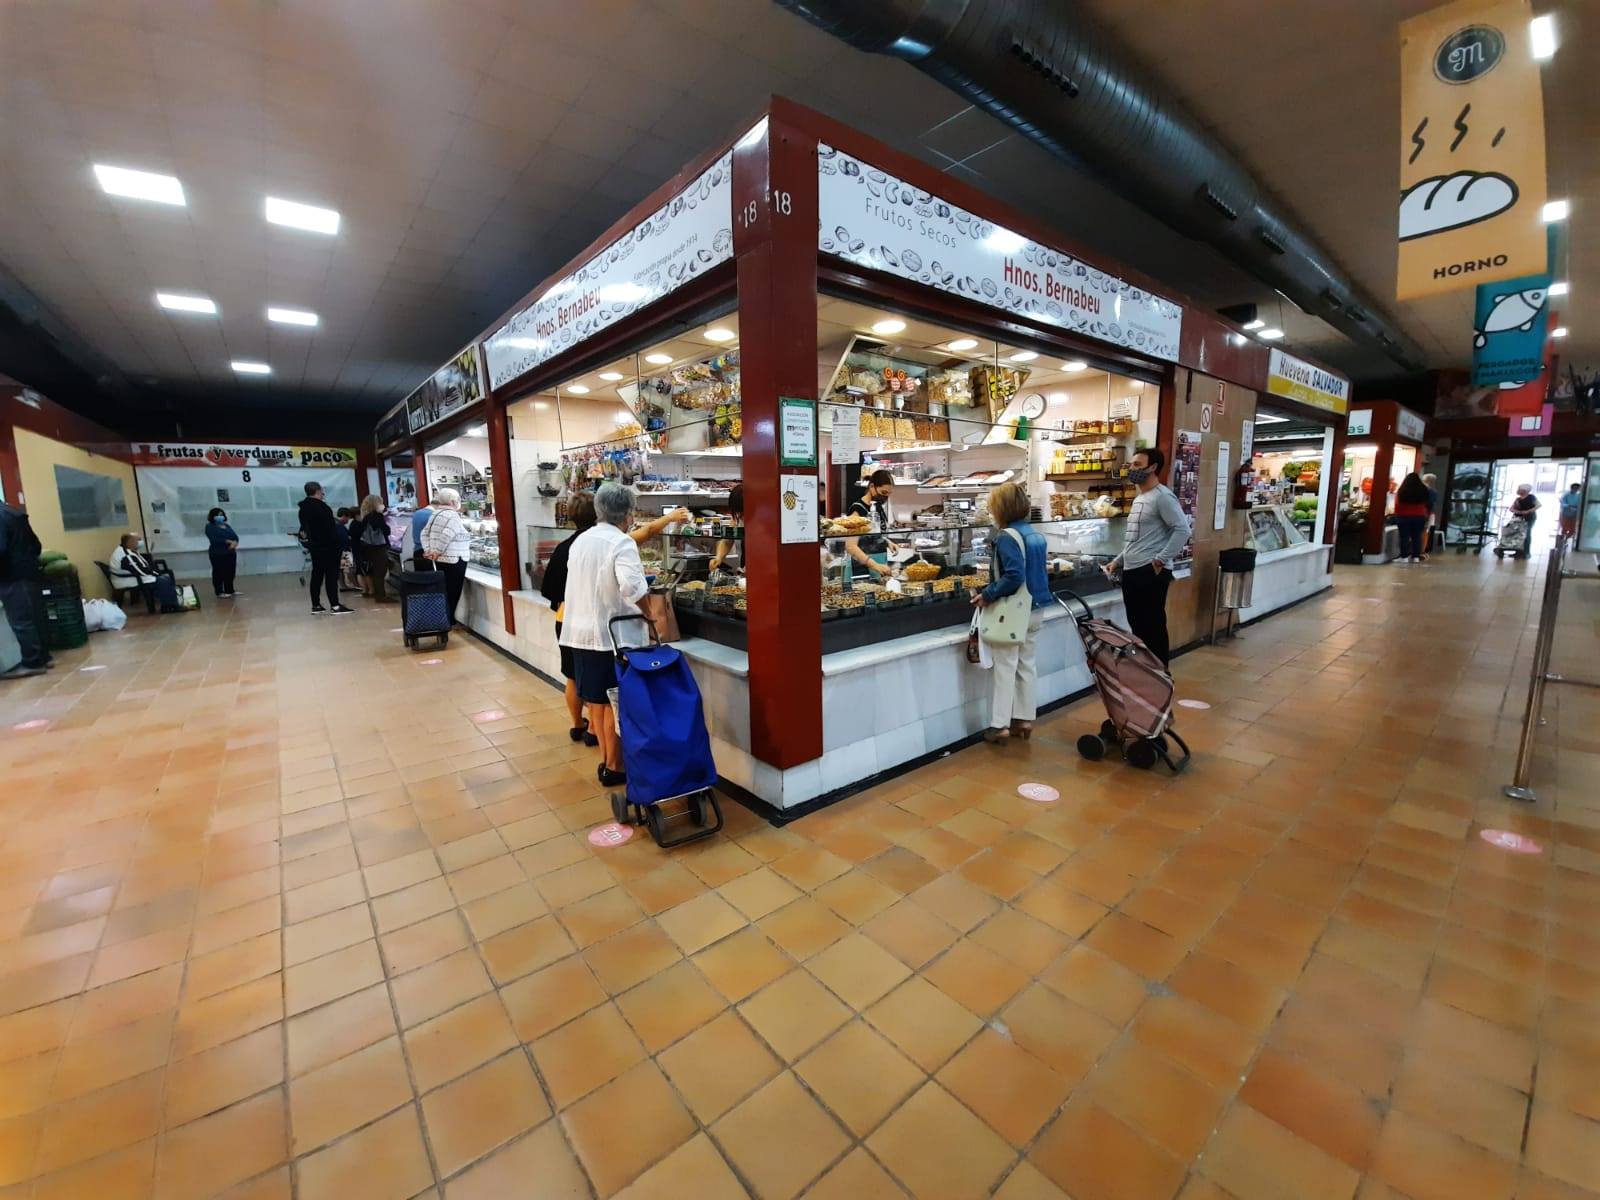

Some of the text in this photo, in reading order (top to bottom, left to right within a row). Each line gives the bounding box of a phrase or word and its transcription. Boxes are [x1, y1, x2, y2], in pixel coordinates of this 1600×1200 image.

[743, 199, 757, 229] 18
[774, 189, 792, 216] 18
[865, 197, 956, 249] Frutos Secos
[1433, 254, 1508, 280] HORNO
[1003, 255, 1101, 315] Hnos. Bernabeu
[535, 285, 601, 339] Hnos. Bernabeu
[1311, 369, 1343, 397] SALVADOR
[157, 444, 342, 465] frutas y verduras paco
[242, 470, 251, 483] 8
